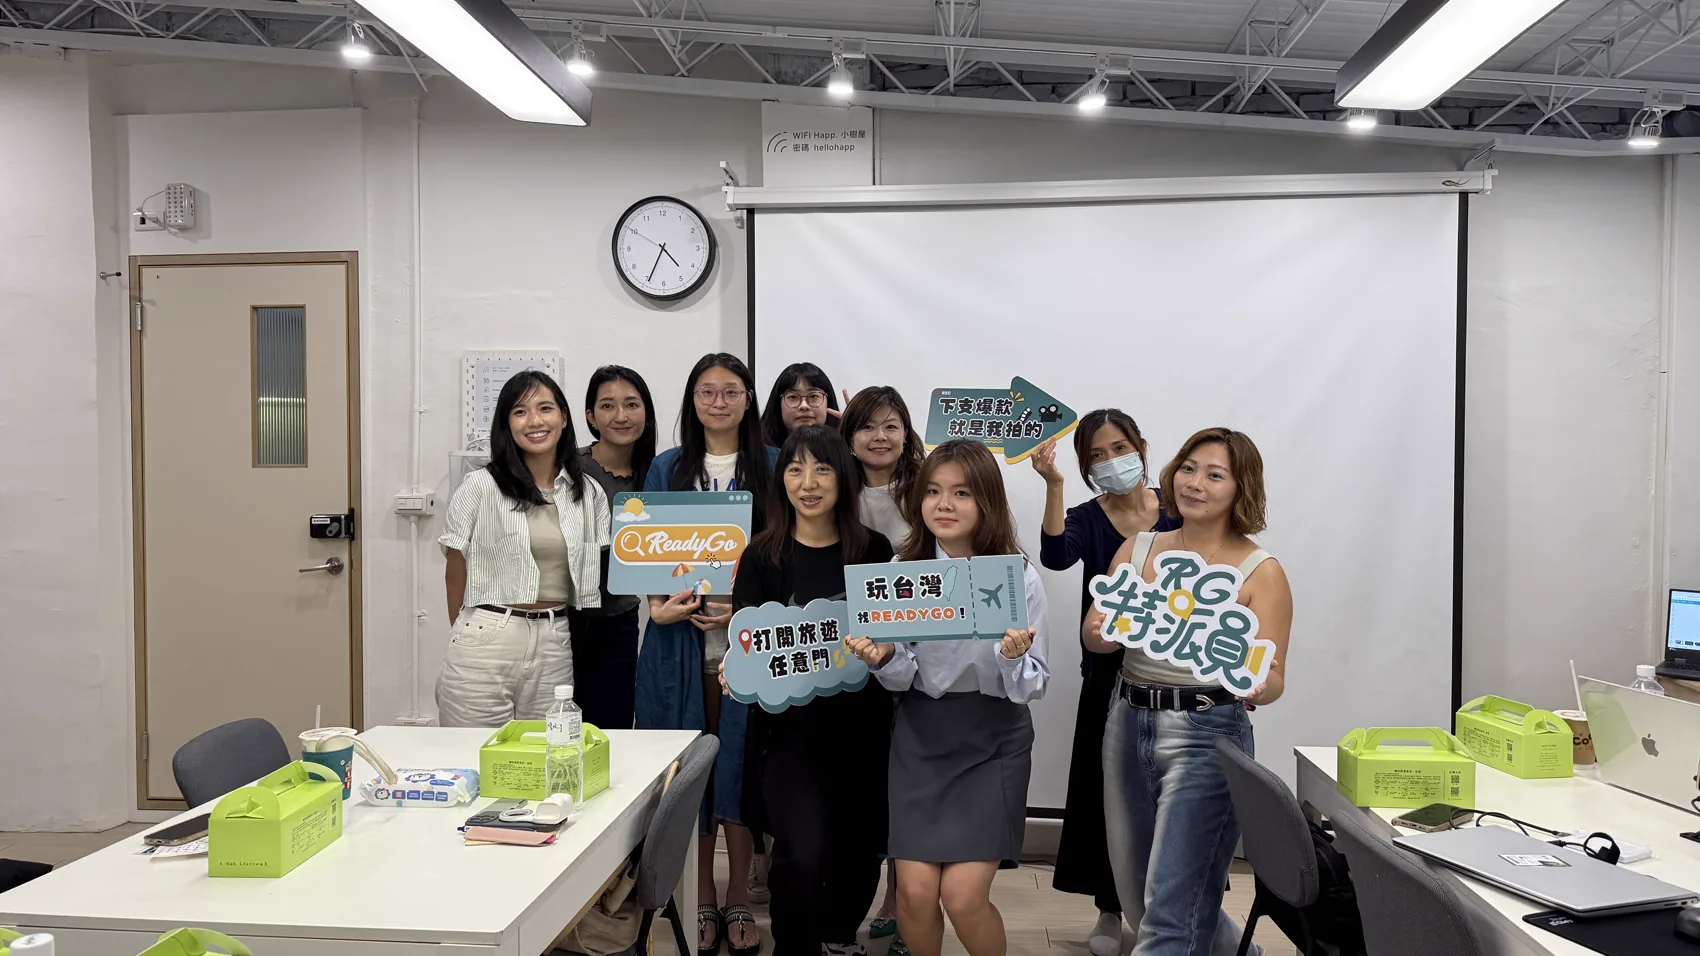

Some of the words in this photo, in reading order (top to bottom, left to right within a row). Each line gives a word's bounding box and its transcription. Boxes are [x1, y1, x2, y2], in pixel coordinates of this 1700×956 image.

[792, 132, 811, 140] WIFI
[813, 131, 838, 141] Happ.
[840, 129, 866, 139] 小樹屋
[792, 143, 810, 153] 密碼
[813, 143, 856, 152] hellohapp
[939, 397, 1014, 416] 下支爆款
[947, 418, 1044, 439] 就是我拍的
[645, 530, 738, 560] ReadyGo
[865, 573, 943, 600] 玩台灣
[1160, 556, 1236, 606] RG
[752, 618, 840, 652] 打開旅遊
[1095, 569, 1252, 690] 特派員
[768, 648, 830, 678] 任意門
